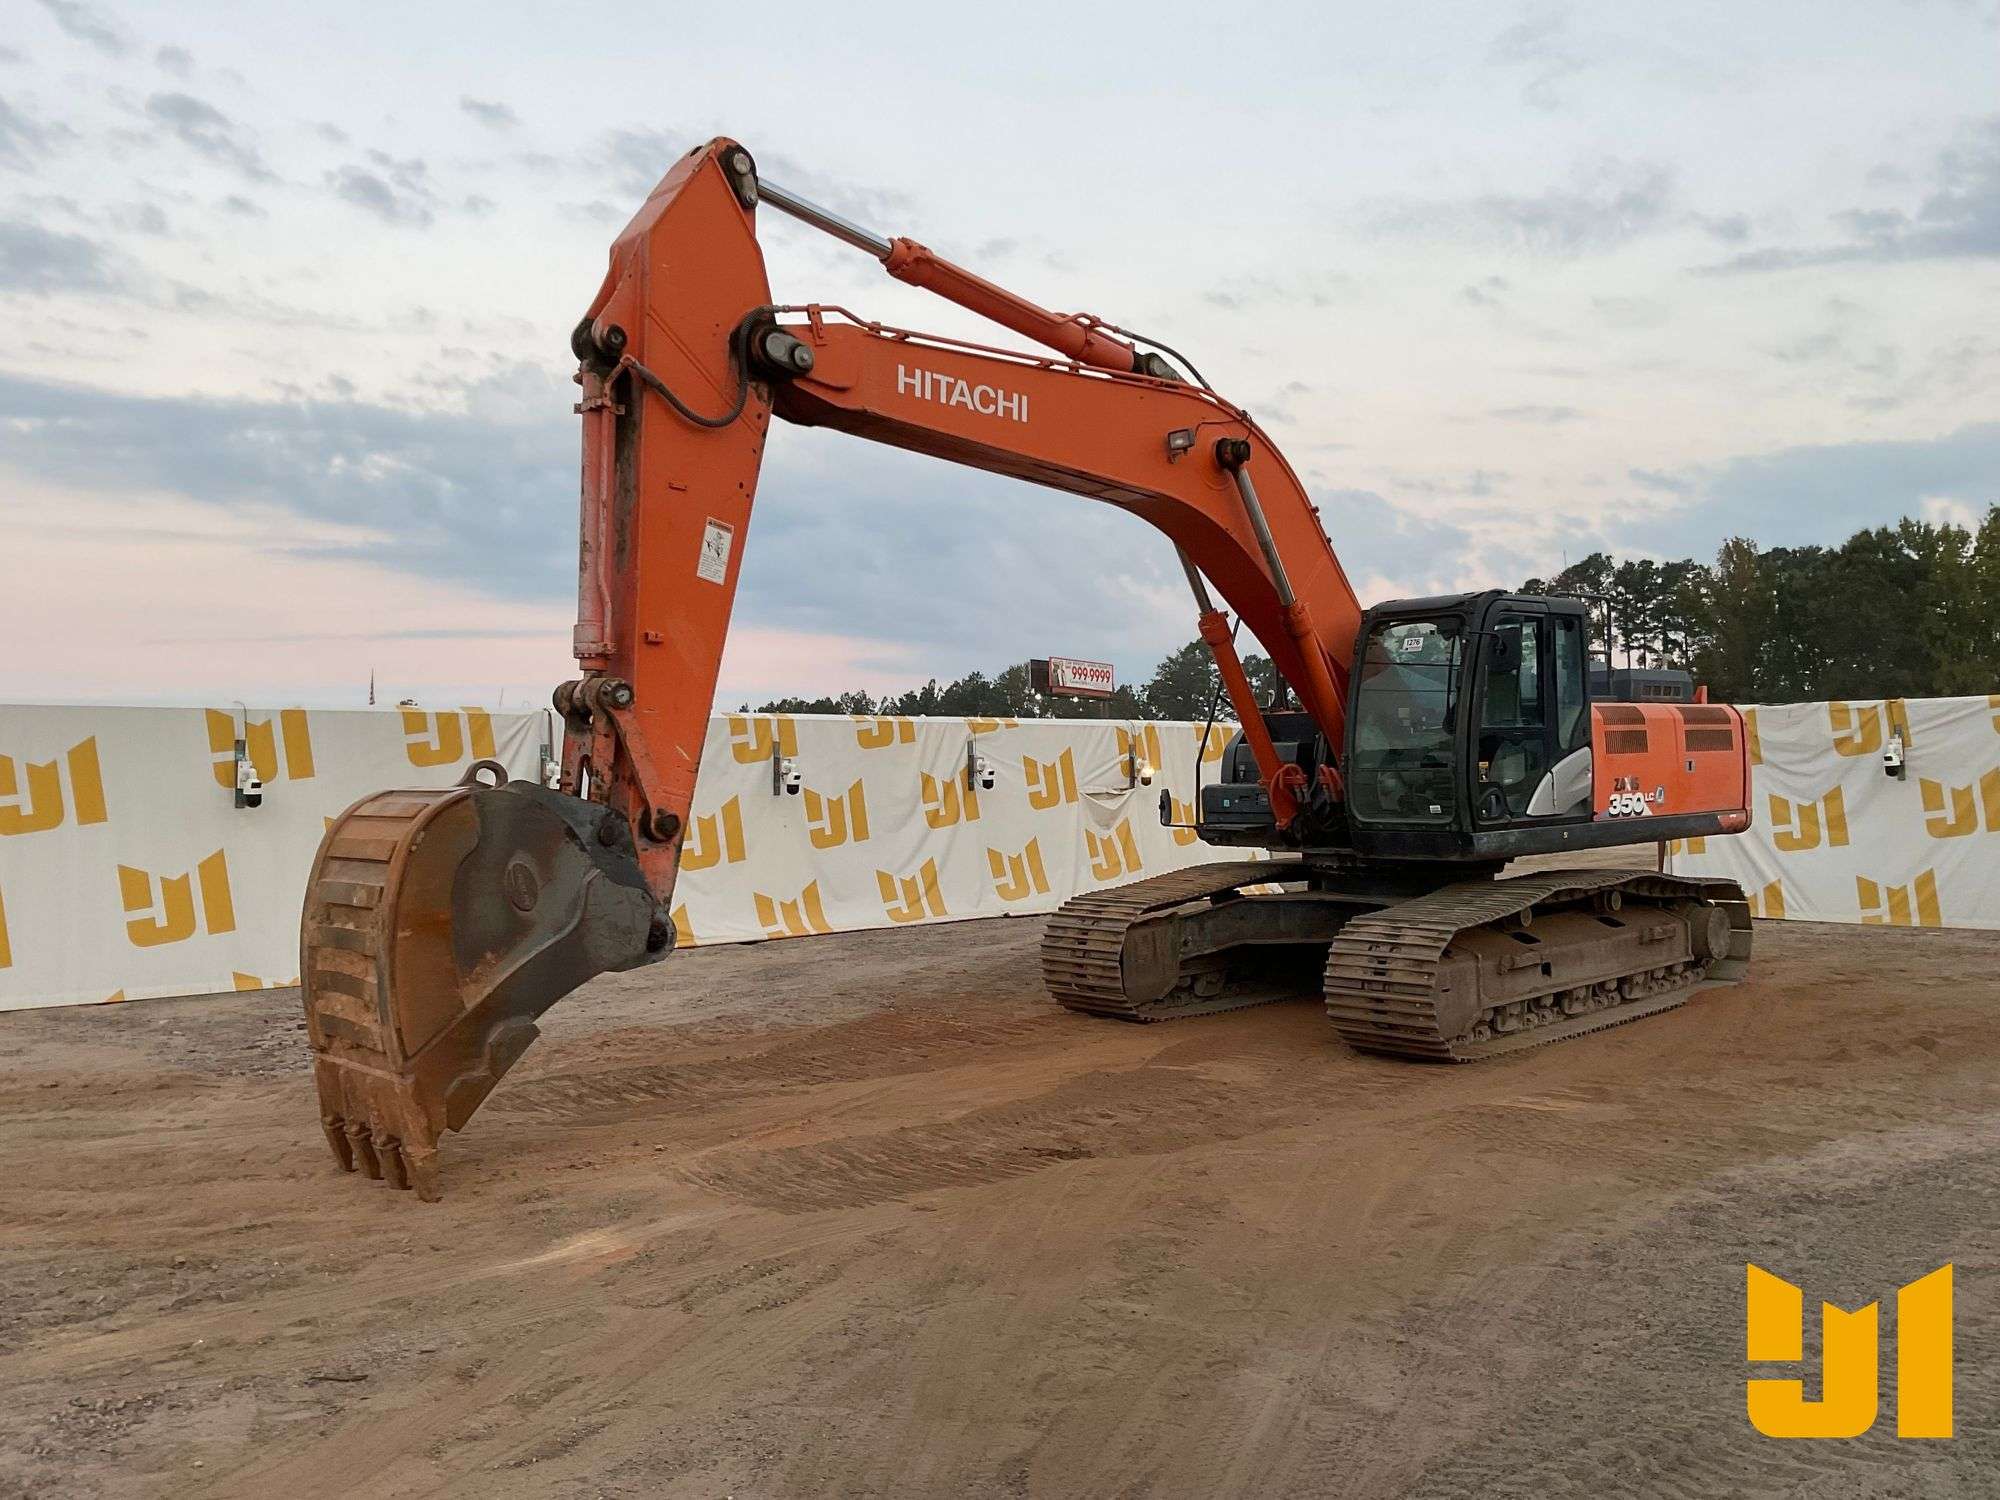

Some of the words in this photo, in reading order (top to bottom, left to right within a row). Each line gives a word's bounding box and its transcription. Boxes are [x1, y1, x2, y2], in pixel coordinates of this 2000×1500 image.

[897, 364, 1028, 423] HITACHI
[1608, 792, 1645, 817] 350
[1645, 791, 1655, 802] LC
